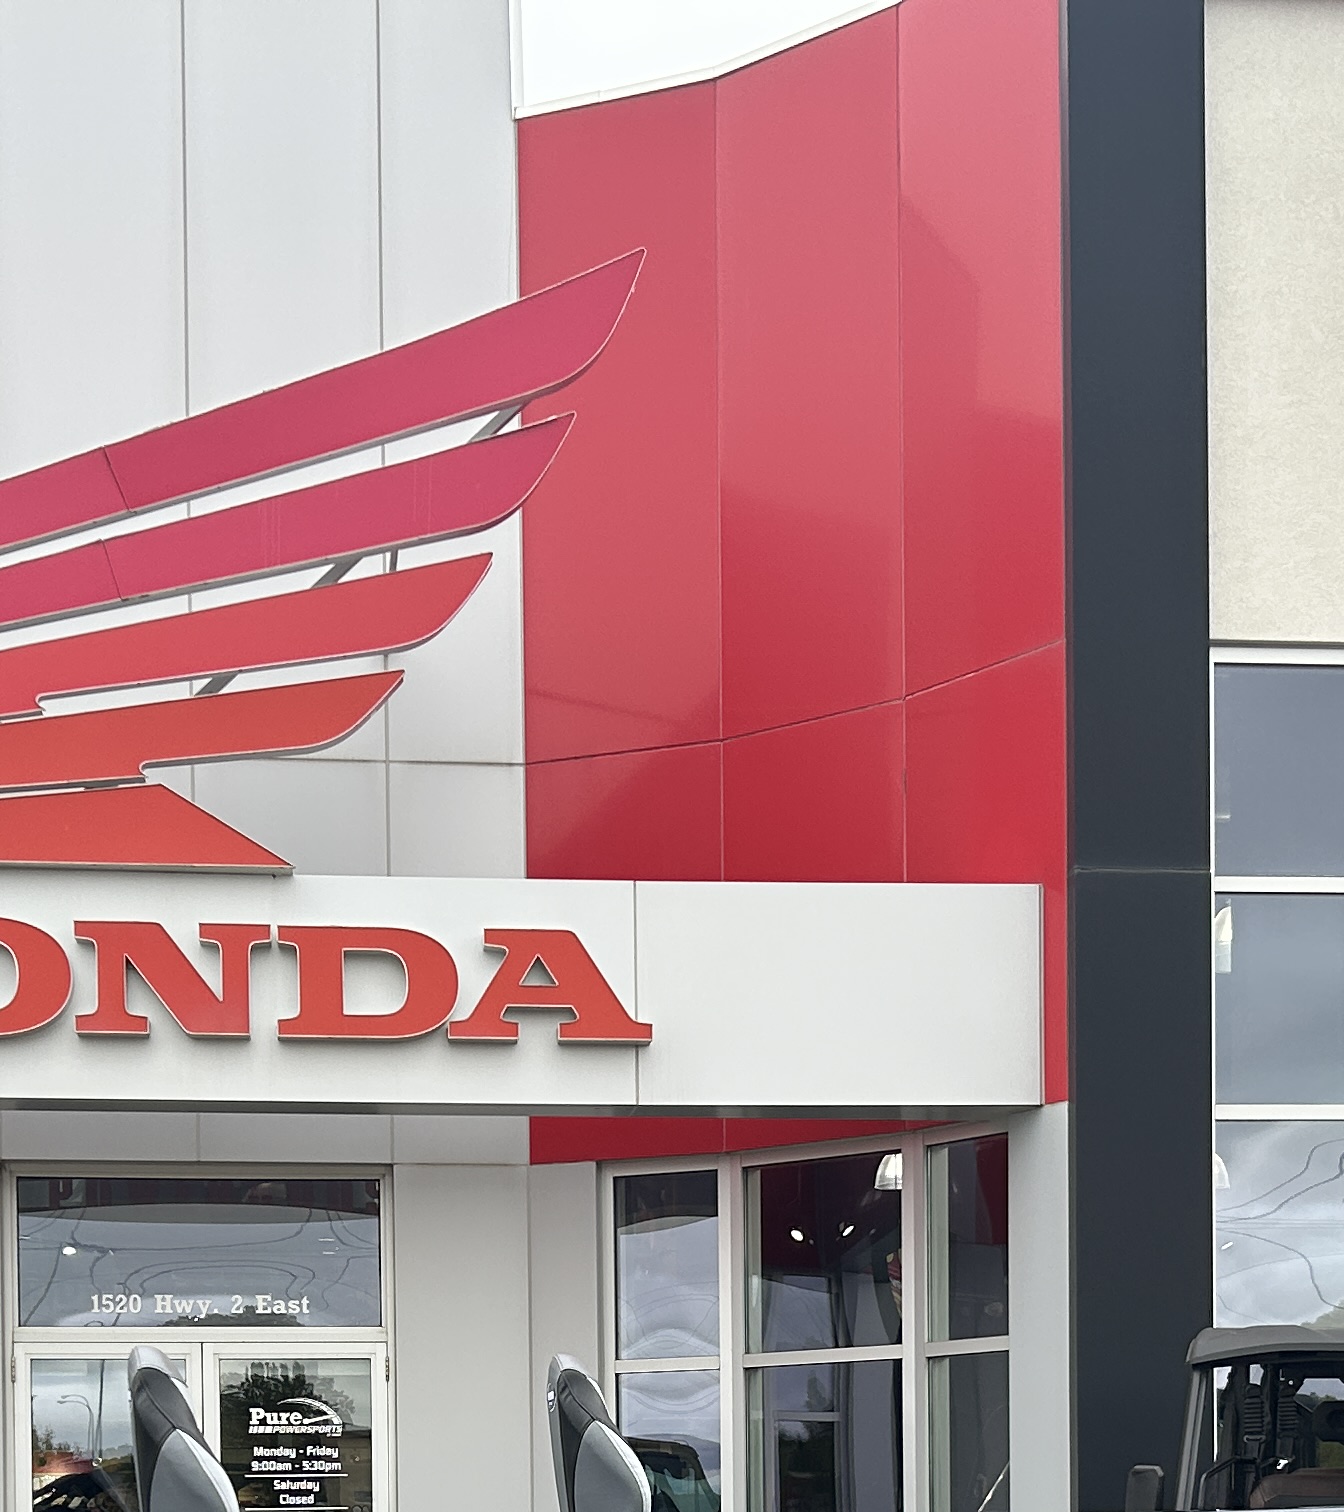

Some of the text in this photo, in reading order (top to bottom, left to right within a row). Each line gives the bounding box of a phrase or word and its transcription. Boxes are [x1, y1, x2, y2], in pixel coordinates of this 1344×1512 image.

[90, 1294, 310, 1319] 1520 Hwy. 2 East
[248, 1407, 303, 1426] Pure
[253, 1446, 296, 1459] Monday
[306, 1445, 339, 1459] Friday
[250, 1460, 293, 1472] 9:00am
[301, 1460, 342, 1473] 5:30pm
[273, 1480, 320, 1492] Saturday
[279, 1494, 315, 1505] Closed
